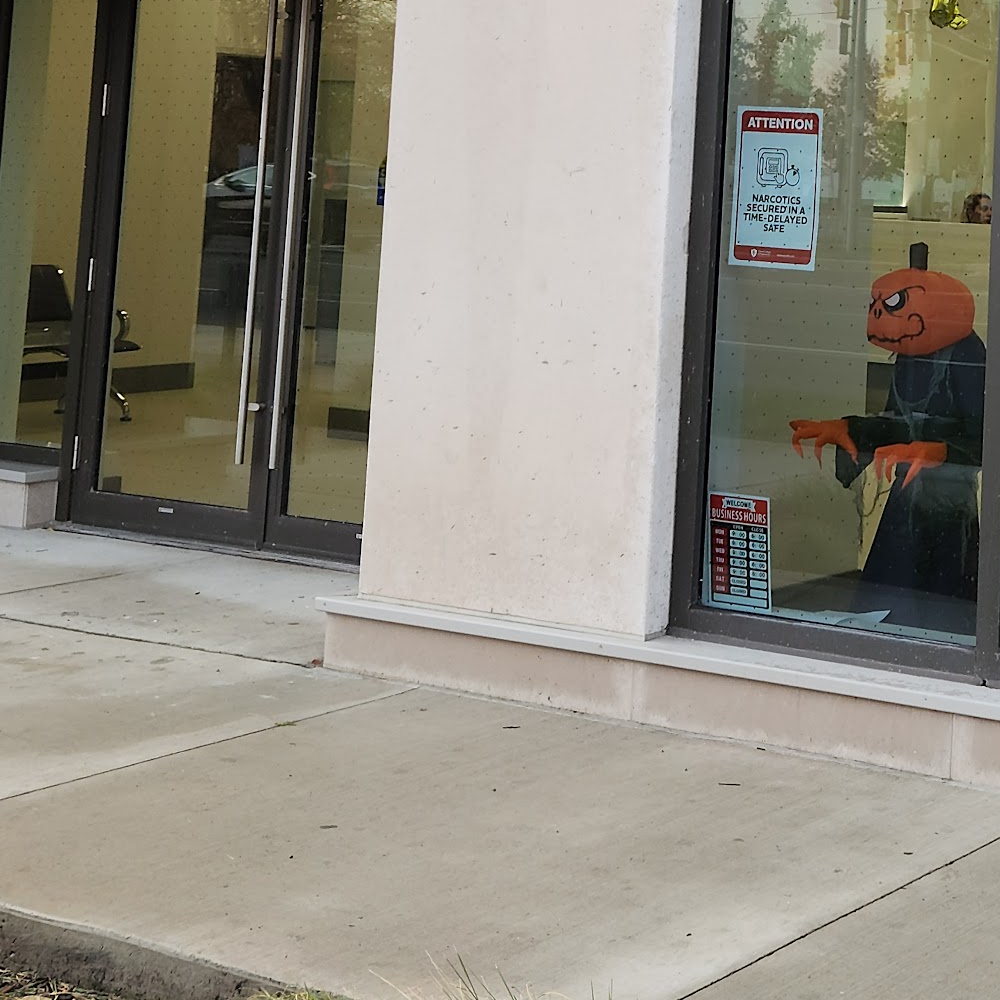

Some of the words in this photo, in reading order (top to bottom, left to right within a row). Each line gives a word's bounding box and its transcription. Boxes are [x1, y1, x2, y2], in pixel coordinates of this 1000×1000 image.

[747, 116, 814, 131] ATTENTION
[752, 194, 801, 204] NARCOTICS
[746, 204, 787, 214] SECURED
[788, 206, 798, 215] IN
[799, 207, 806, 215] A
[743, 213, 808, 225] TIME-DELAYED
[763, 224, 785, 233] SAFE
[726, 499, 752, 509] WELCOME
[711, 508, 743, 521] BUSINESS
[743, 511, 767, 524] HOURS
